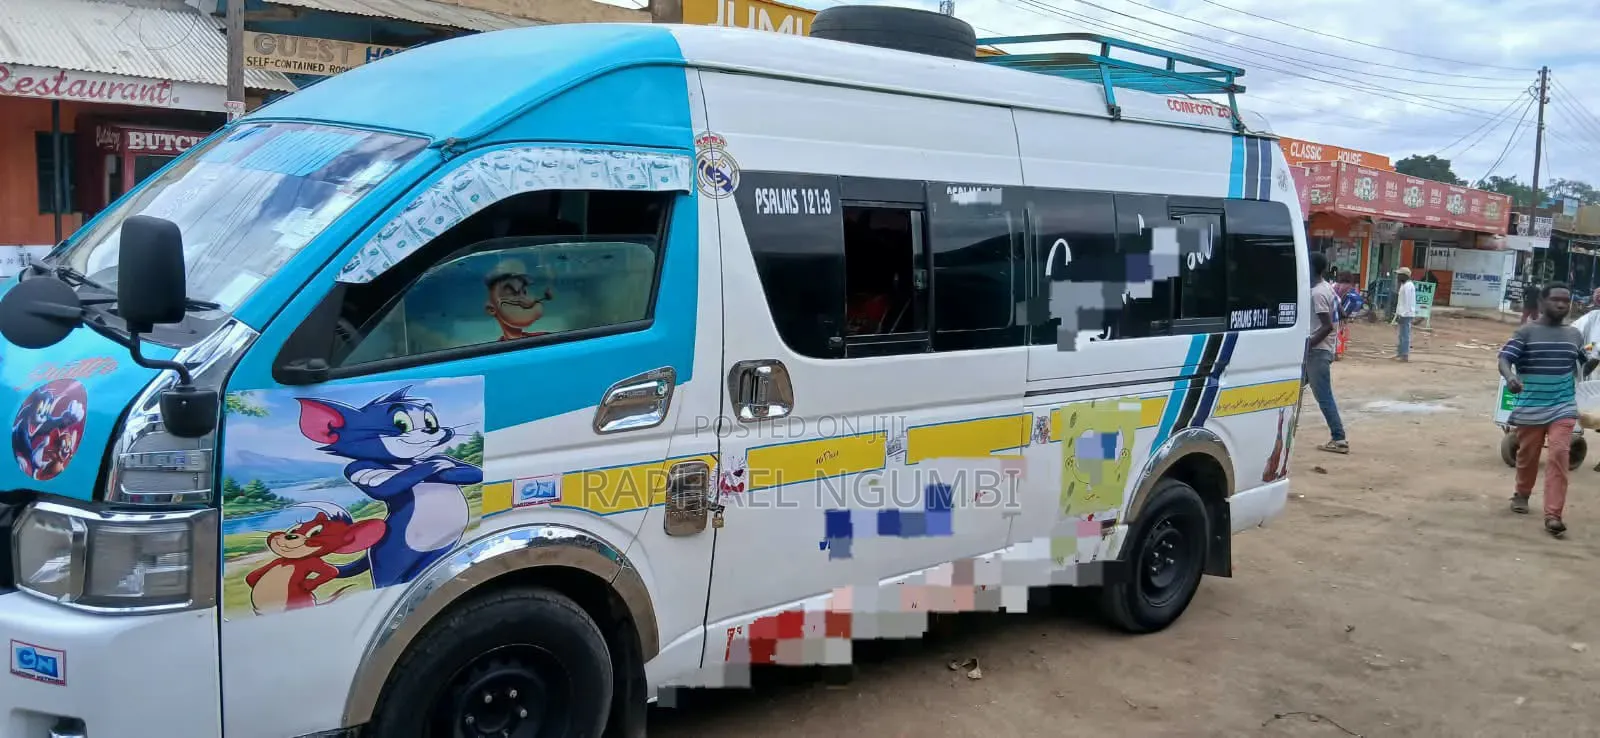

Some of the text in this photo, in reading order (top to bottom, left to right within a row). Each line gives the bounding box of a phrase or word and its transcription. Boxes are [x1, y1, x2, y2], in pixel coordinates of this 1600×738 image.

[254, 34, 354, 65] GUEST
[247, 57, 325, 73] SELF-CONTAINED
[1167, 99, 1214, 116] COMFORT
[1290, 142, 1362, 166] CLASSIC HOUSE
[755, 187, 832, 215] PSALMS 121:8
[1230, 309, 1253, 329] PSALMS
[1253, 308, 1269, 327] 91:11
[520, 480, 556, 500] CN
[15, 646, 59, 678] CN
